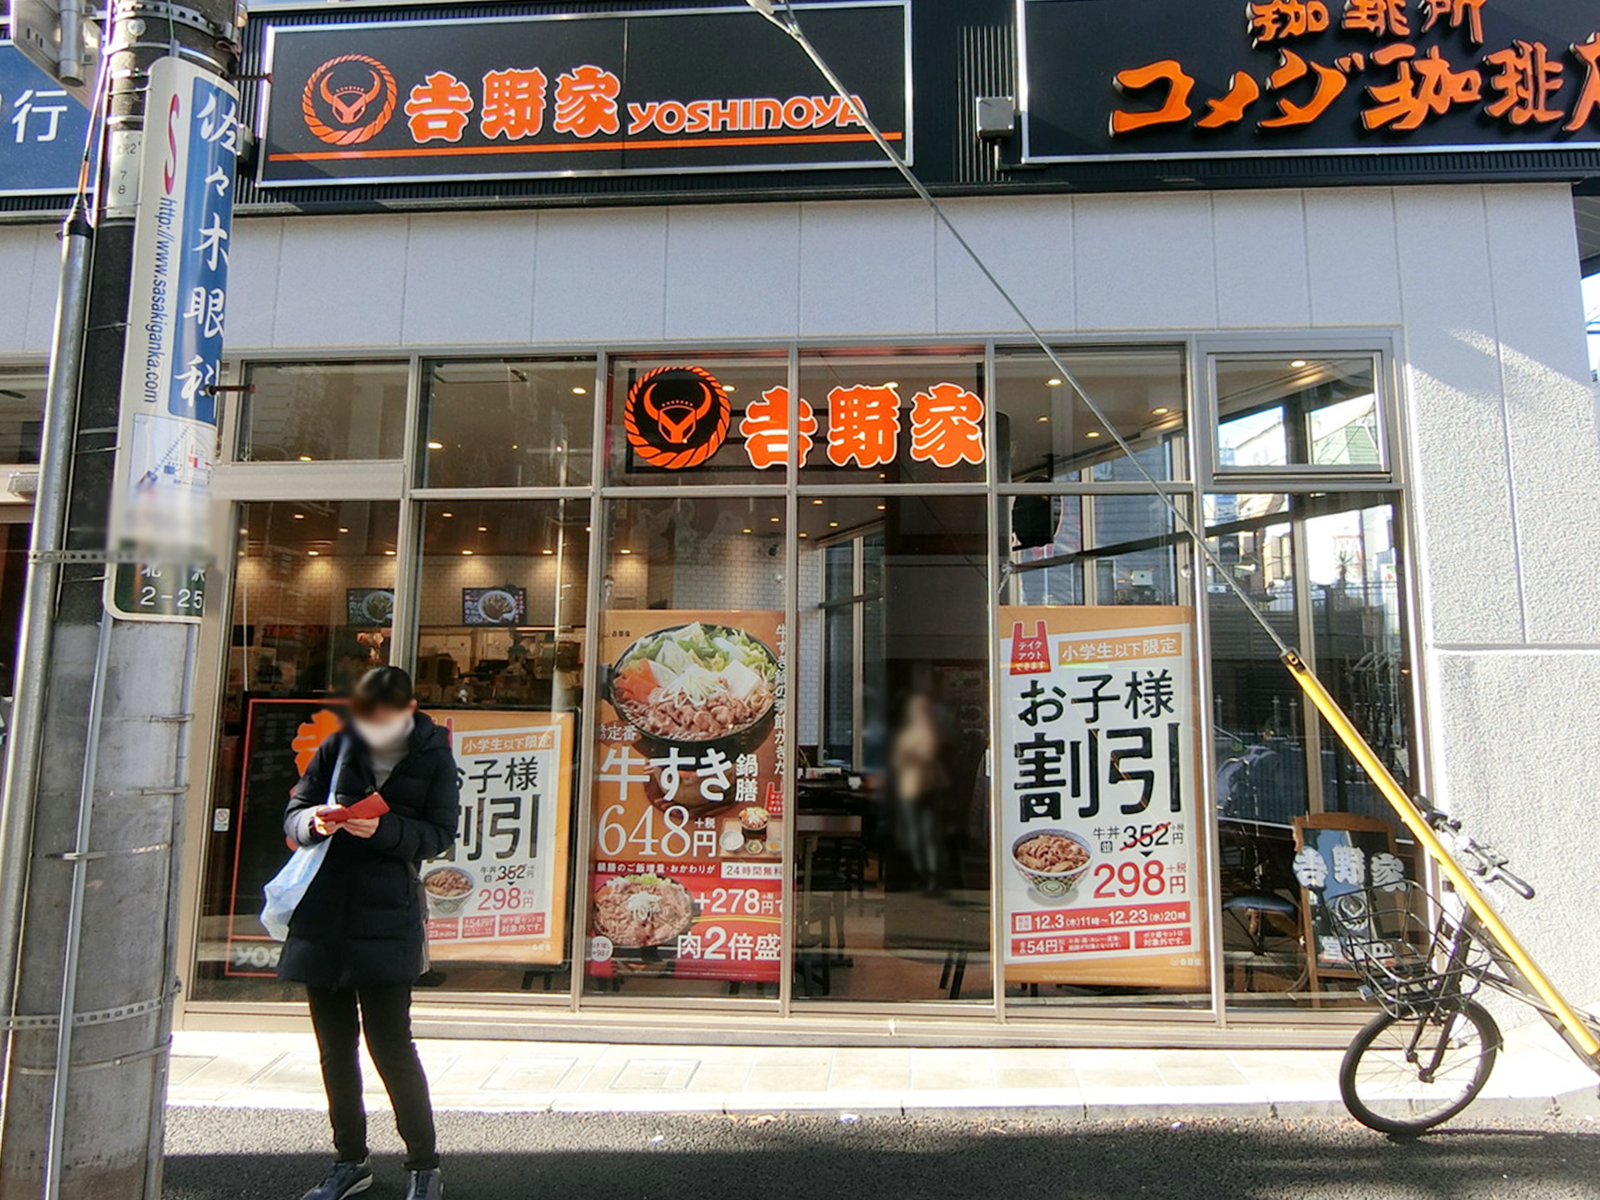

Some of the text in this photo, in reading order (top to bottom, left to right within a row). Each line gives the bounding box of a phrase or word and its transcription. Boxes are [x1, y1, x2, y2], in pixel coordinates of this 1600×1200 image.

[403, 64, 868, 144] 吉野家 YOSHINOYA
[144, 196, 178, 404] http://www.sasakiganka.com
[739, 382, 985, 469] 吉野家
[1018, 640, 1043, 650] テイク
[1018, 651, 1042, 660] アウト
[1061, 637, 1177, 662] 小学生以下限定
[1017, 668, 1175, 727] お子様
[1013, 722, 1182, 823] 割引
